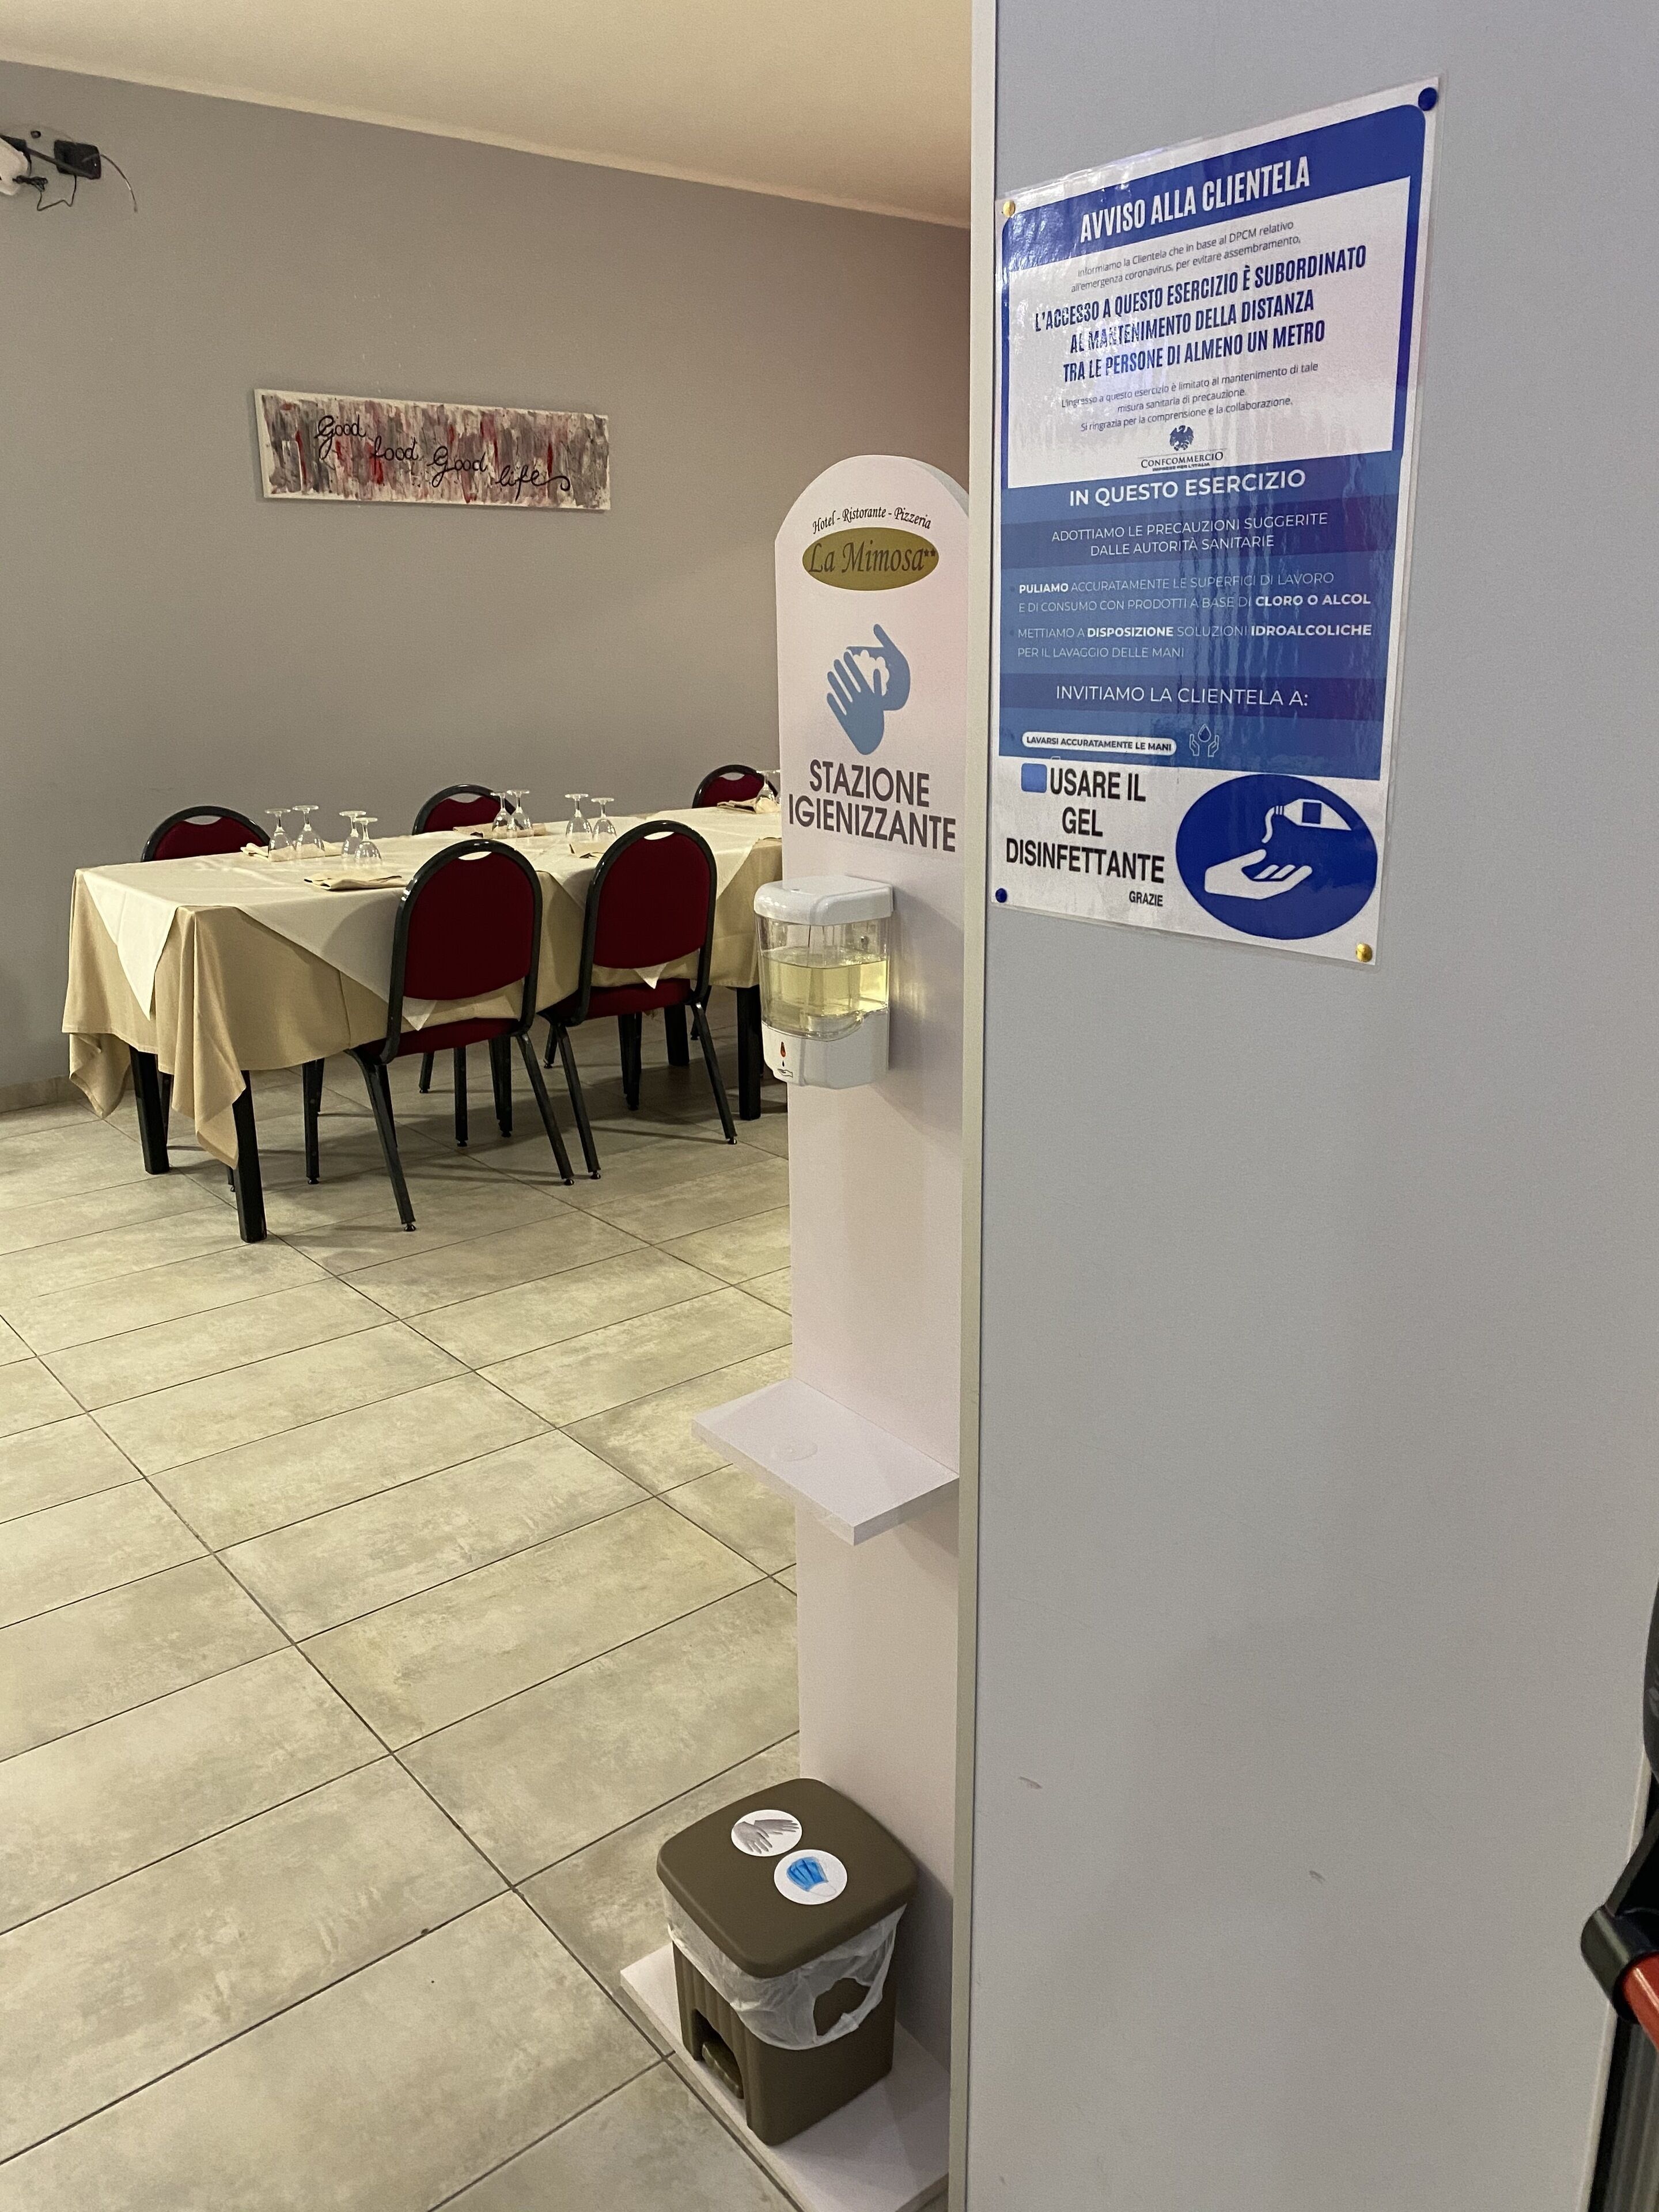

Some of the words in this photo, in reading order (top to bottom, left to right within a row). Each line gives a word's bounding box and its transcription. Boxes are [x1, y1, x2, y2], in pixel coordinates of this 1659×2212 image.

[1081, 199, 1145, 243] AVVISO
[1151, 186, 1196, 225] ALLA
[1203, 156, 1309, 211] CLIENTELA
[1124, 259, 1131, 267] la
[1132, 251, 1166, 265] Clientela
[1169, 246, 1183, 257] che
[1186, 244, 1194, 252] in
[1196, 238, 1216, 251] base
[1219, 237, 1226, 245] al
[1229, 229, 1256, 244] DPCM
[1259, 221, 1294, 236] relativo
[1071, 276, 1122, 293] all'emergenza
[1125, 265, 1173, 283] coronavirus,
[1176, 260, 1190, 272] per
[1192, 254, 1222, 267] evitare
[1035, 301, 1099, 332] L'ACCESSO
[1103, 300, 1111, 318] A
[1115, 287, 1162, 317] QUESTO
[1167, 275, 1236, 305] ESERCIZIO
[1243, 265, 1251, 290] È
[1254, 245, 1367, 286] SUBORDINATO
[1088, 313, 1191, 351] MANTENIMENTO
[1195, 305, 1236, 331] DELLA
[1241, 289, 1313, 323] DISTANZA
[1063, 362, 1085, 382] TRA
[1089, 359, 1102, 378] LE
[1105, 347, 1163, 376] PERSONE
[1168, 346, 1181, 365] DI
[1184, 335, 1242, 363] ALMENO
[1247, 332, 1268, 352] UN
[1272, 320, 1325, 349] METRO
[1106, 391, 1132, 403] questo
[1134, 385, 1168, 397] esercizio
[1171, 383, 1176, 392] è
[1179, 378, 1209, 390] limitato
[1212, 377, 1219, 386] al
[1222, 367, 1287, 384] mantenimento
[1290, 365, 1298, 374] di
[1301, 362, 1317, 373] tale
[1118, 402, 1144, 414] misura
[1146, 397, 1180, 409] sanitaria
[1183, 394, 1190, 404] di
[1192, 388, 1246, 404] precauzione.
[1081, 423, 1087, 431] Si
[1089, 419, 1121, 432] ringrazia
[1123, 416, 1137, 428] per
[1139, 415, 1145, 423] la
[1147, 407, 1206, 424] comprensione
[1216, 404, 1223, 414] la
[315, 415, 366, 460] Good
[369, 435, 419, 475] food
[427, 446, 487, 488] Good
[495, 465, 571, 502] life
[1070, 489, 1088, 506] IN
[1095, 481, 1178, 505] QUESTO
[1186, 469, 1305, 496] ESERCIZIO
[812, 510, 836, 534] Hotel
[842, 506, 886, 522] Ristorante
[894, 507, 931, 529] Pizzeria
[1052, 527, 1125, 541] ADOTTIAMO
[1128, 525, 1143, 537] LE
[1147, 518, 1240, 536] PRECAUZIONI
[1244, 513, 1328, 529] SUGGERITE
[809, 543, 835, 572] La
[1091, 541, 1130, 556] DALLE
[1133, 535, 1198, 554] AUTORITÀ
[1201, 535, 1274, 550] SANITARIE
[1020, 583, 1069, 594] PULIAMO
[1071, 579, 1169, 592] ACCURATAMENTE
[1173, 578, 1187, 589] LE
[1190, 575, 1255, 588] SUPERFICI
[1260, 575, 1272, 585] DI
[1278, 573, 1334, 585] LAVORO
[1020, 603, 1025, 612] E
[1028, 603, 1038, 612] DI
[1041, 601, 1097, 612] CONSUMO
[1100, 600, 1124, 610] CON
[1128, 599, 1186, 609] PRODOTTI
[1191, 599, 1199, 607] A
[1202, 597, 1234, 607] BASE
[1239, 597, 1251, 606] DI
[1256, 596, 1303, 606] CLORO
[1308, 595, 1318, 605] O
[1323, 593, 1370, 605] ALCOL
[1018, 628, 1074, 638] METTIAMO
[1077, 628, 1085, 637] A
[1088, 627, 1173, 637] DISPOSIZIONE
[1177, 626, 1247, 637] SOLUZIONI
[1251, 624, 1372, 636] IDROALCOLICHE
[1018, 648, 1038, 657] PER
[1042, 648, 1050, 657] IL
[1054, 648, 1108, 657] LAVAGGIO
[1112, 647, 1148, 657] DELLE
[1152, 647, 1183, 658] MANI
[1056, 685, 1145, 700] INVITIAMO
[1150, 688, 1172, 702] LA
[1178, 688, 1283, 705] CLIENTELA
[1289, 691, 1308, 706] A:
[1060, 738, 1132, 749] ACCURATAMENTE
[1135, 741, 1146, 749] LE
[1149, 741, 1171, 751] MANI
[810, 759, 929, 807] STAZIONE
[1051, 768, 1120, 799] USARE
[1128, 774, 1146, 802] IL
[789, 794, 956, 852] IGIENIZZANTE
[1062, 807, 1103, 836] GEL
[1006, 838, 1164, 883] DISINFETTANTE
[1130, 891, 1163, 907] GRAZIE
